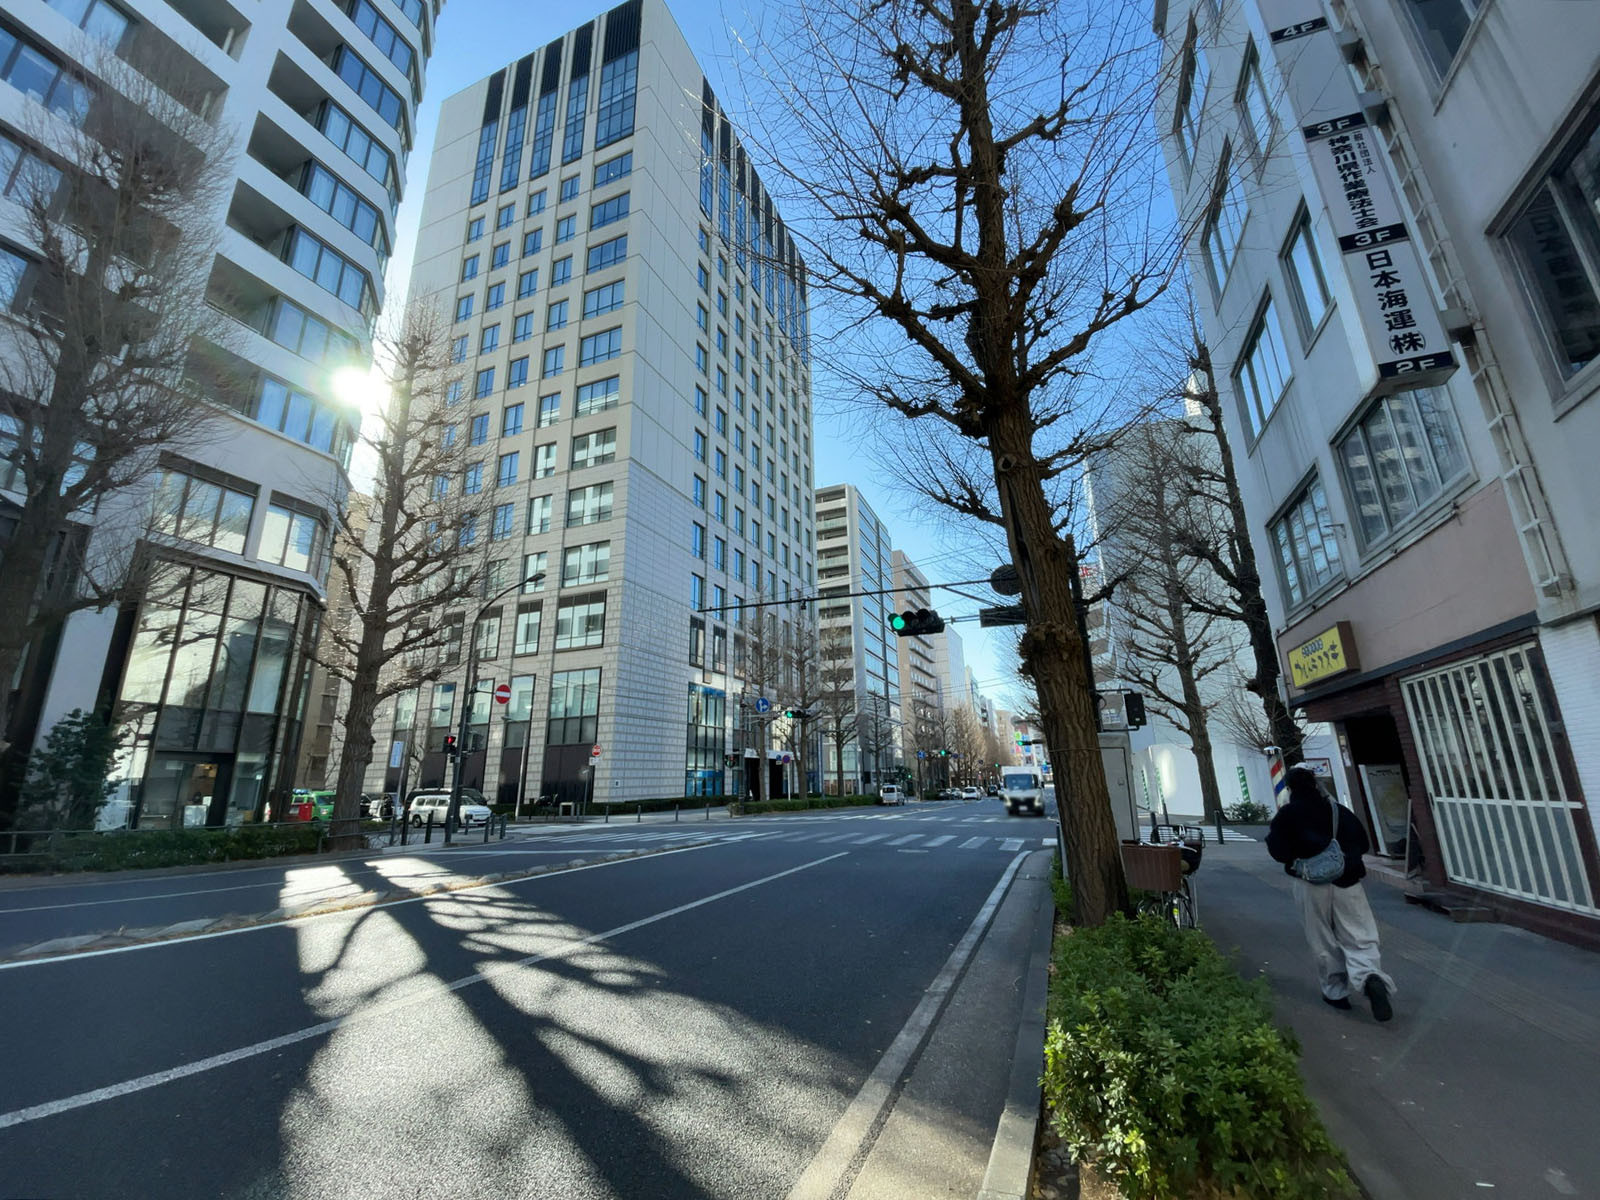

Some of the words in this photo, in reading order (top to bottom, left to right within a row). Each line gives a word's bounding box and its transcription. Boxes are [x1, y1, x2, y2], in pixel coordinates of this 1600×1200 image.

[1283, 22, 1315, 37] 4F
[1317, 118, 1351, 135] 3F
[1328, 135, 1378, 230] 神奈川県作業療法士会
[1354, 229, 1391, 246] 3F
[1396, 358, 1436, 373] 2F
